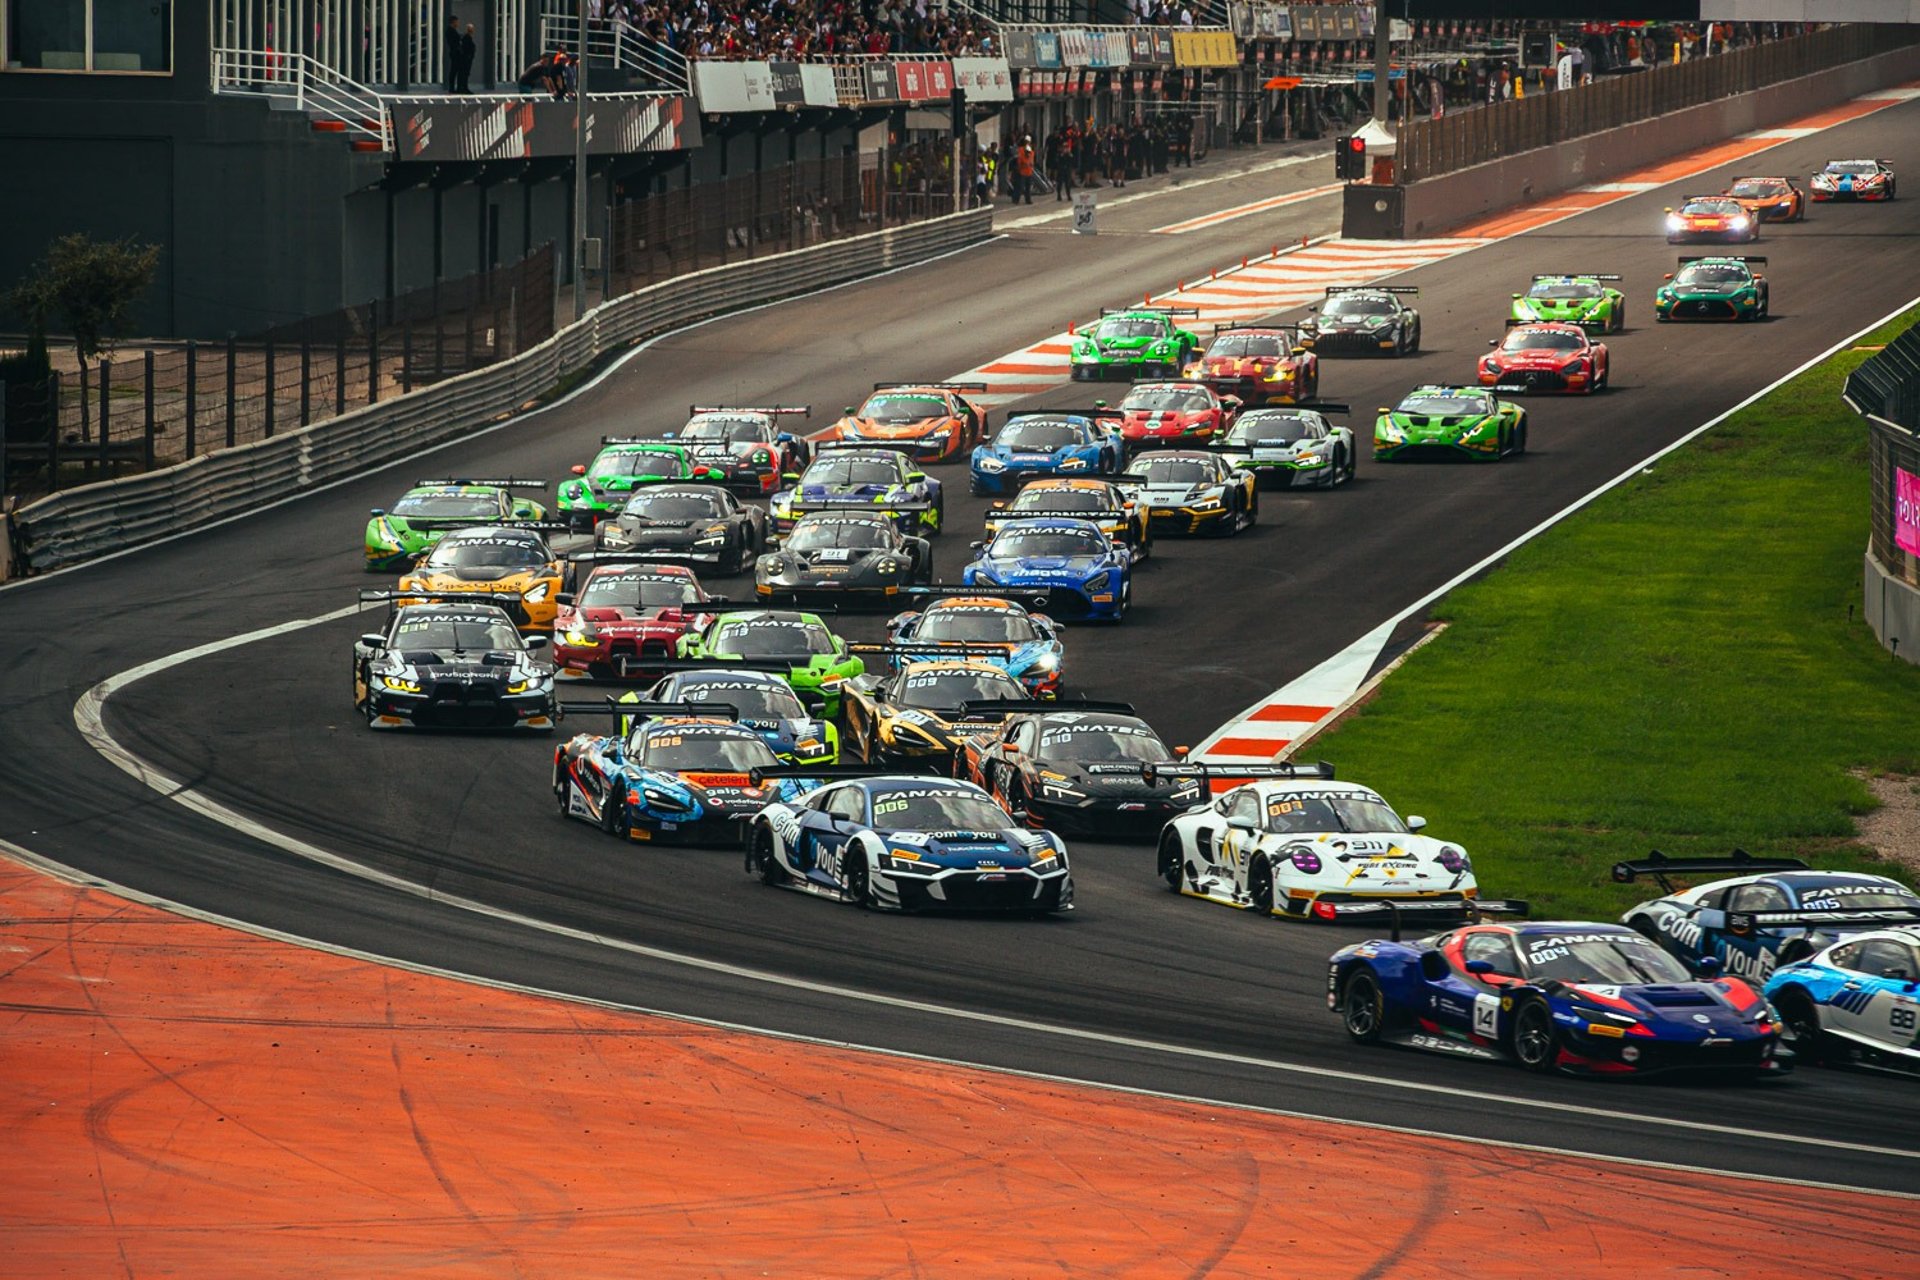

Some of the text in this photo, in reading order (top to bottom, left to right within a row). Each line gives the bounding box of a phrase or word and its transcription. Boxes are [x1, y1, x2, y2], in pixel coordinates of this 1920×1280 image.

[1009, 420, 1079, 430] FANATEC
[817, 456, 894, 464] FANATEC
[1133, 457, 1211, 465] FANATEC
[634, 492, 715, 501] FANATEC
[1021, 487, 1103, 496] FANATEC
[800, 517, 884, 528] FANATEC
[1004, 527, 1091, 538] FANATEC
[443, 537, 532, 549] FANATEC
[597, 575, 688, 585] FANATEC
[926, 606, 1021, 616] FANATEC
[405, 614, 503, 624] FANATEC
[723, 621, 821, 631] FANATEC
[907, 670, 1009, 681] FANATEC
[680, 682, 788, 694] FANATEC
[907, 677, 938, 688] 009
[648, 727, 755, 739] FANATEC
[1043, 724, 1151, 737] FANATEC
[706, 788, 740, 796] galp
[876, 789, 989, 802] FANATEC
[1268, 791, 1382, 804] FANATEC
[874, 800, 909, 815] 006
[1352, 840, 1383, 850] 911
[815, 842, 835, 877] you
[1801, 886, 1915, 901] FANATEC
[1529, 934, 1651, 951] FANATEC
[1528, 945, 1570, 965] 004
[1722, 944, 1757, 979] you
[1476, 1006, 1495, 1029] 14
[1890, 1007, 1916, 1030] 88
